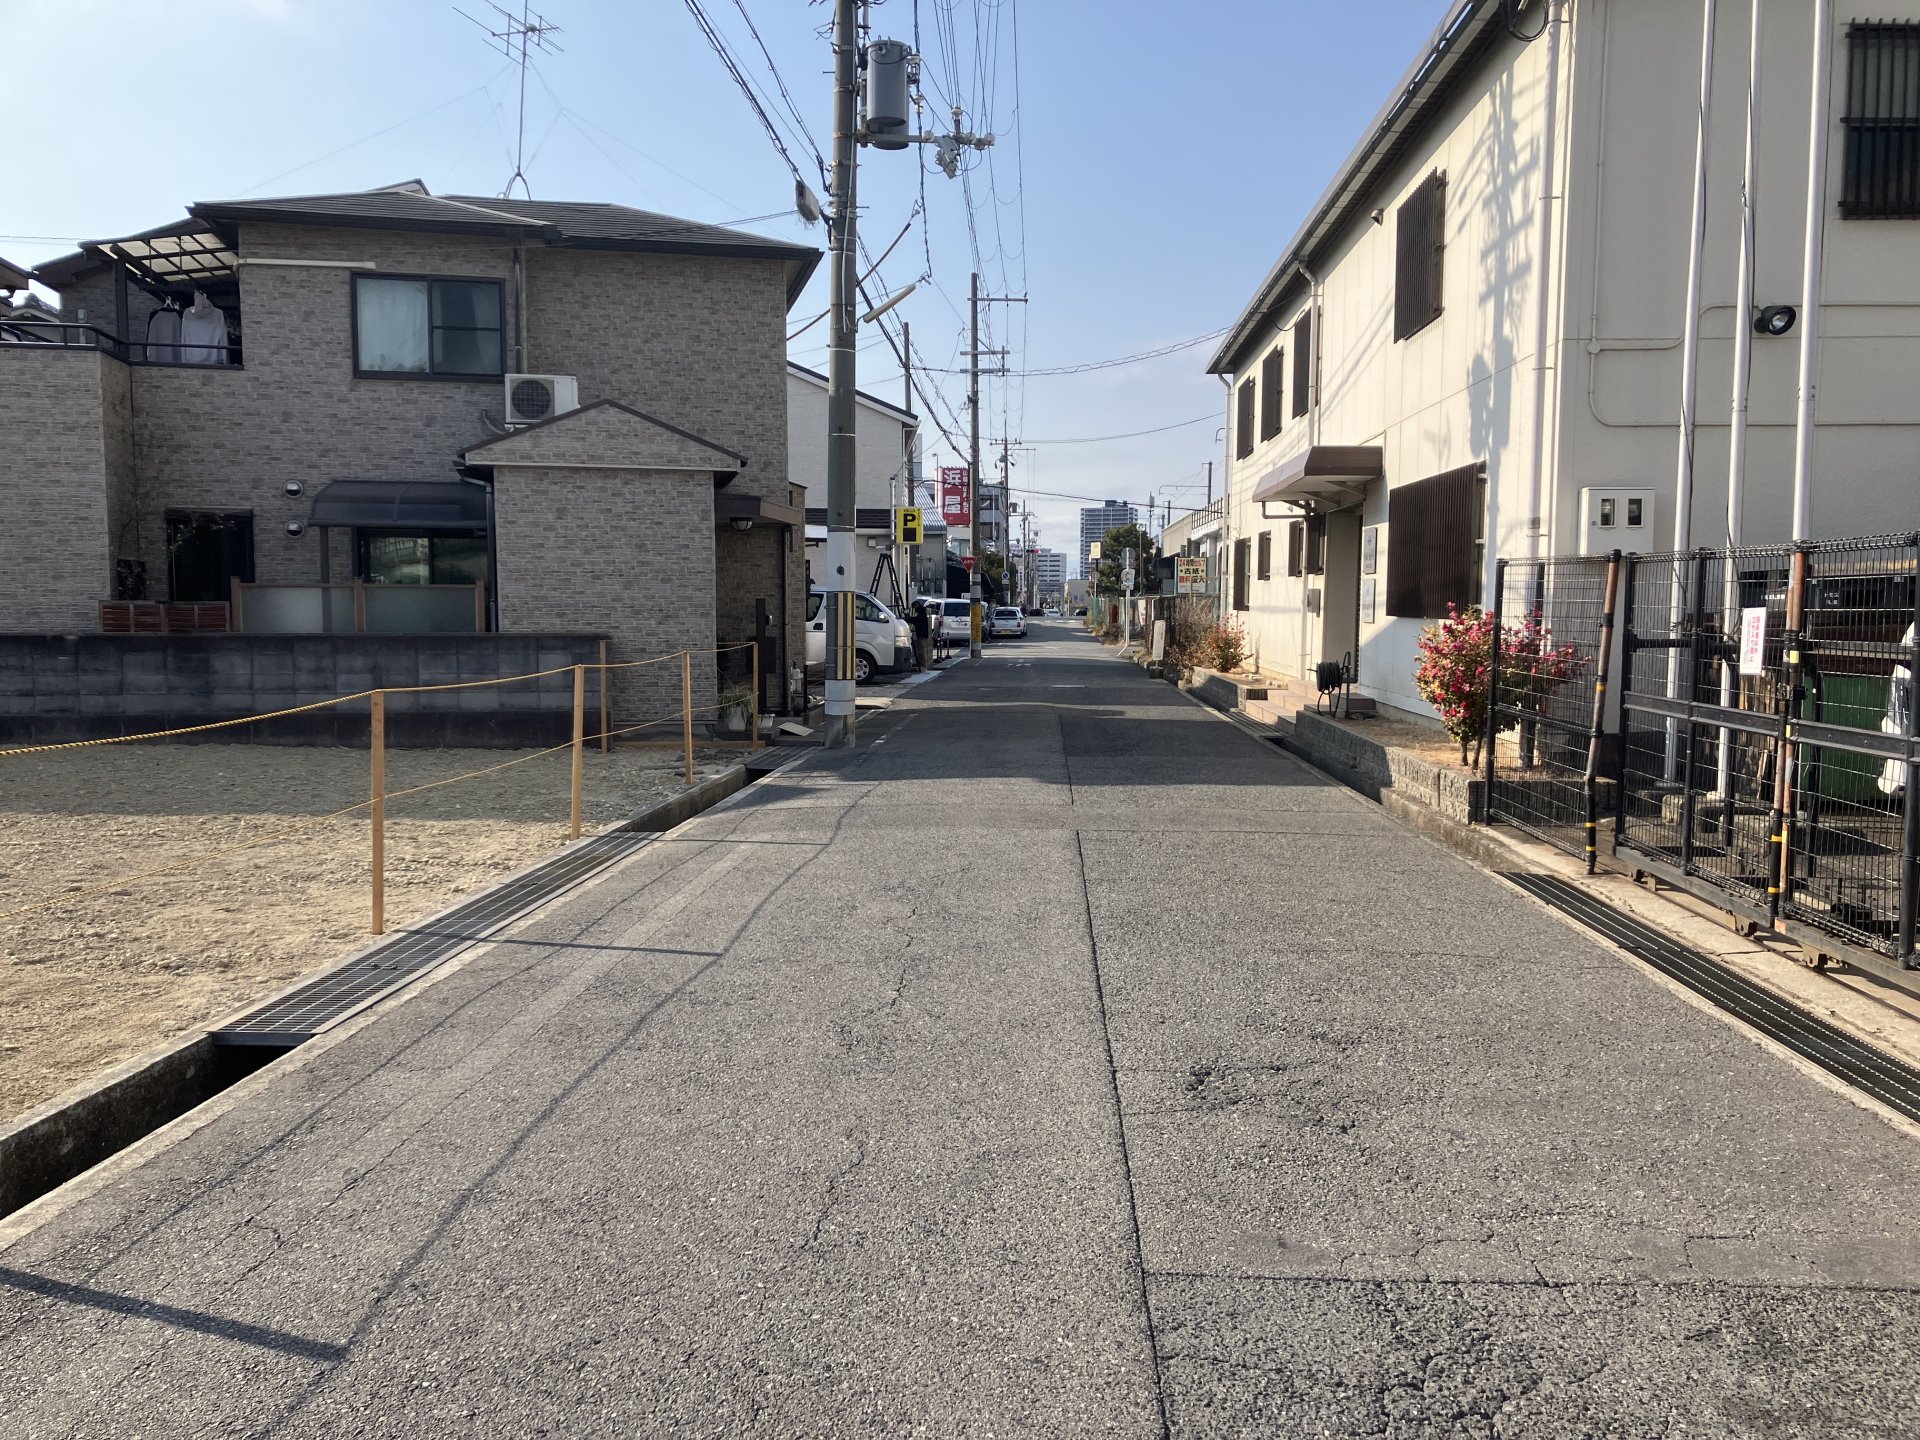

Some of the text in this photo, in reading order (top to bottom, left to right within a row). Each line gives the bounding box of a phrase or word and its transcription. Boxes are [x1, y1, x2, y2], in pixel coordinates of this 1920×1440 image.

[944, 469, 962, 514] 浜屋
[903, 513, 917, 526] P
[1184, 567, 1200, 575] 古紙
